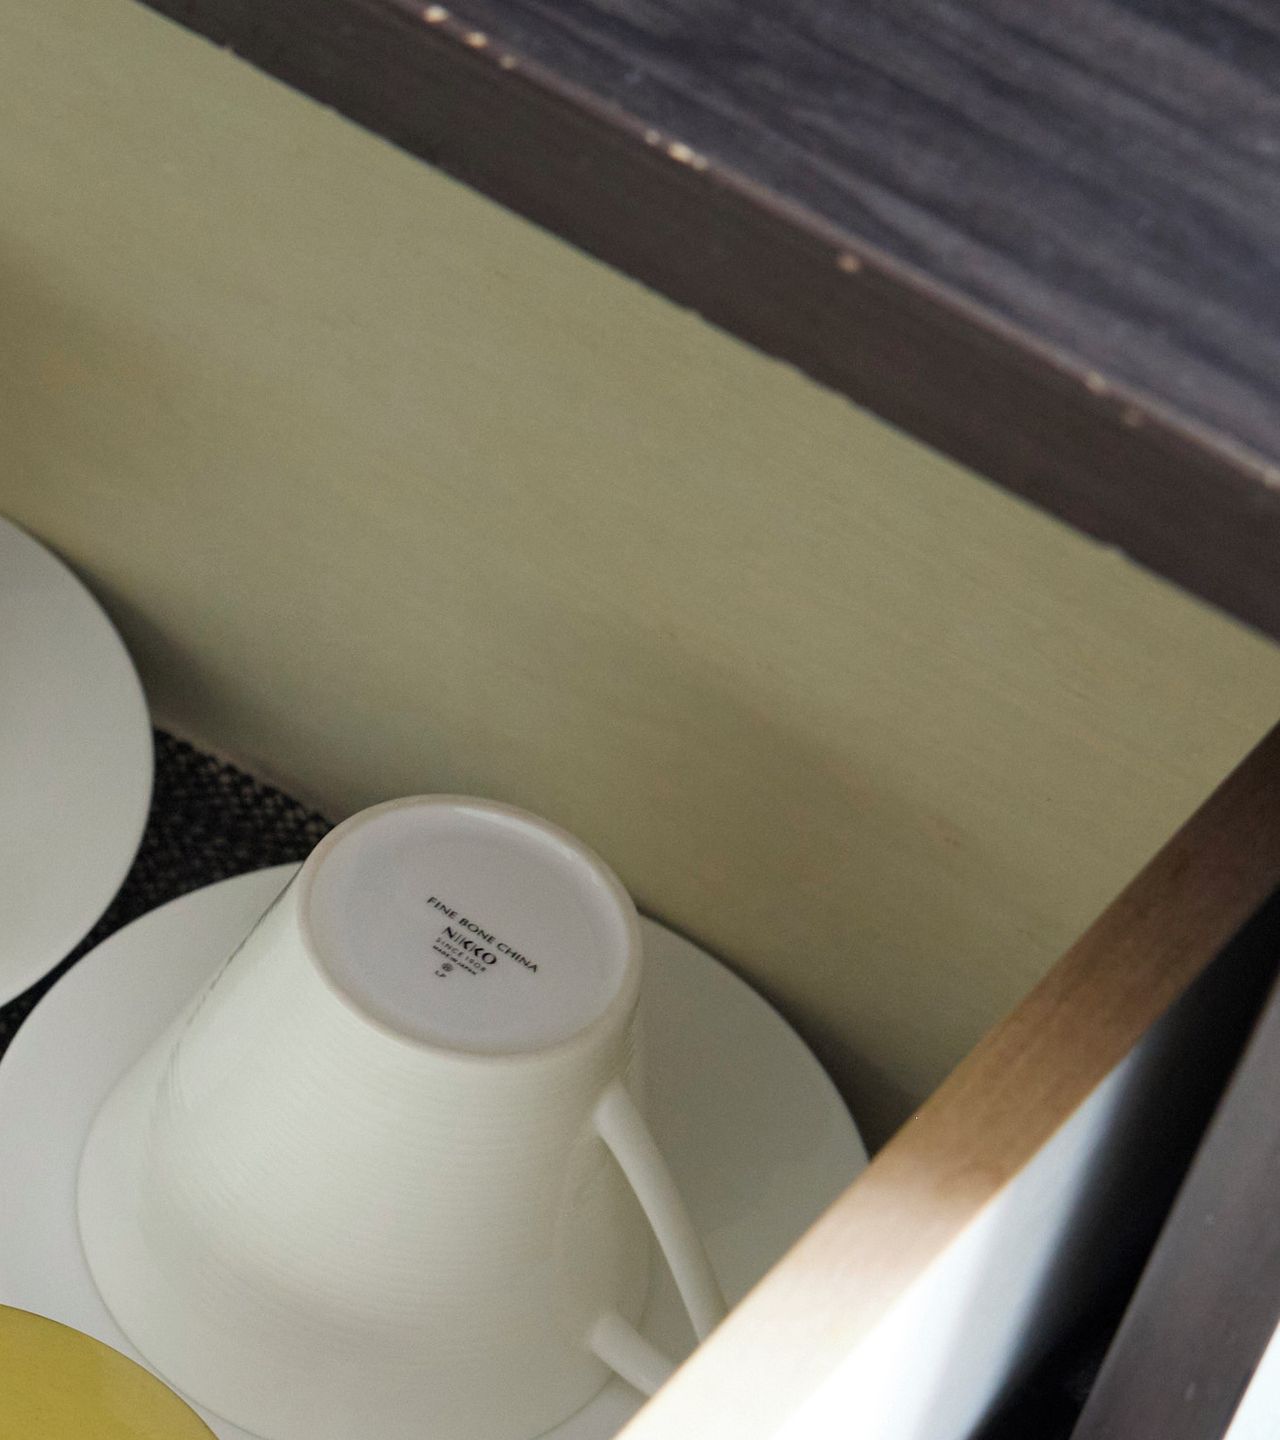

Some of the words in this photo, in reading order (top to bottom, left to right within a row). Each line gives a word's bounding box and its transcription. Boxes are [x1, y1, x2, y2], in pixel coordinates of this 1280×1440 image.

[426, 896, 458, 920] FINE
[458, 917, 496, 945] BONE
[496, 942, 538, 974] CHINA
[441, 926, 497, 965] NIKKO
